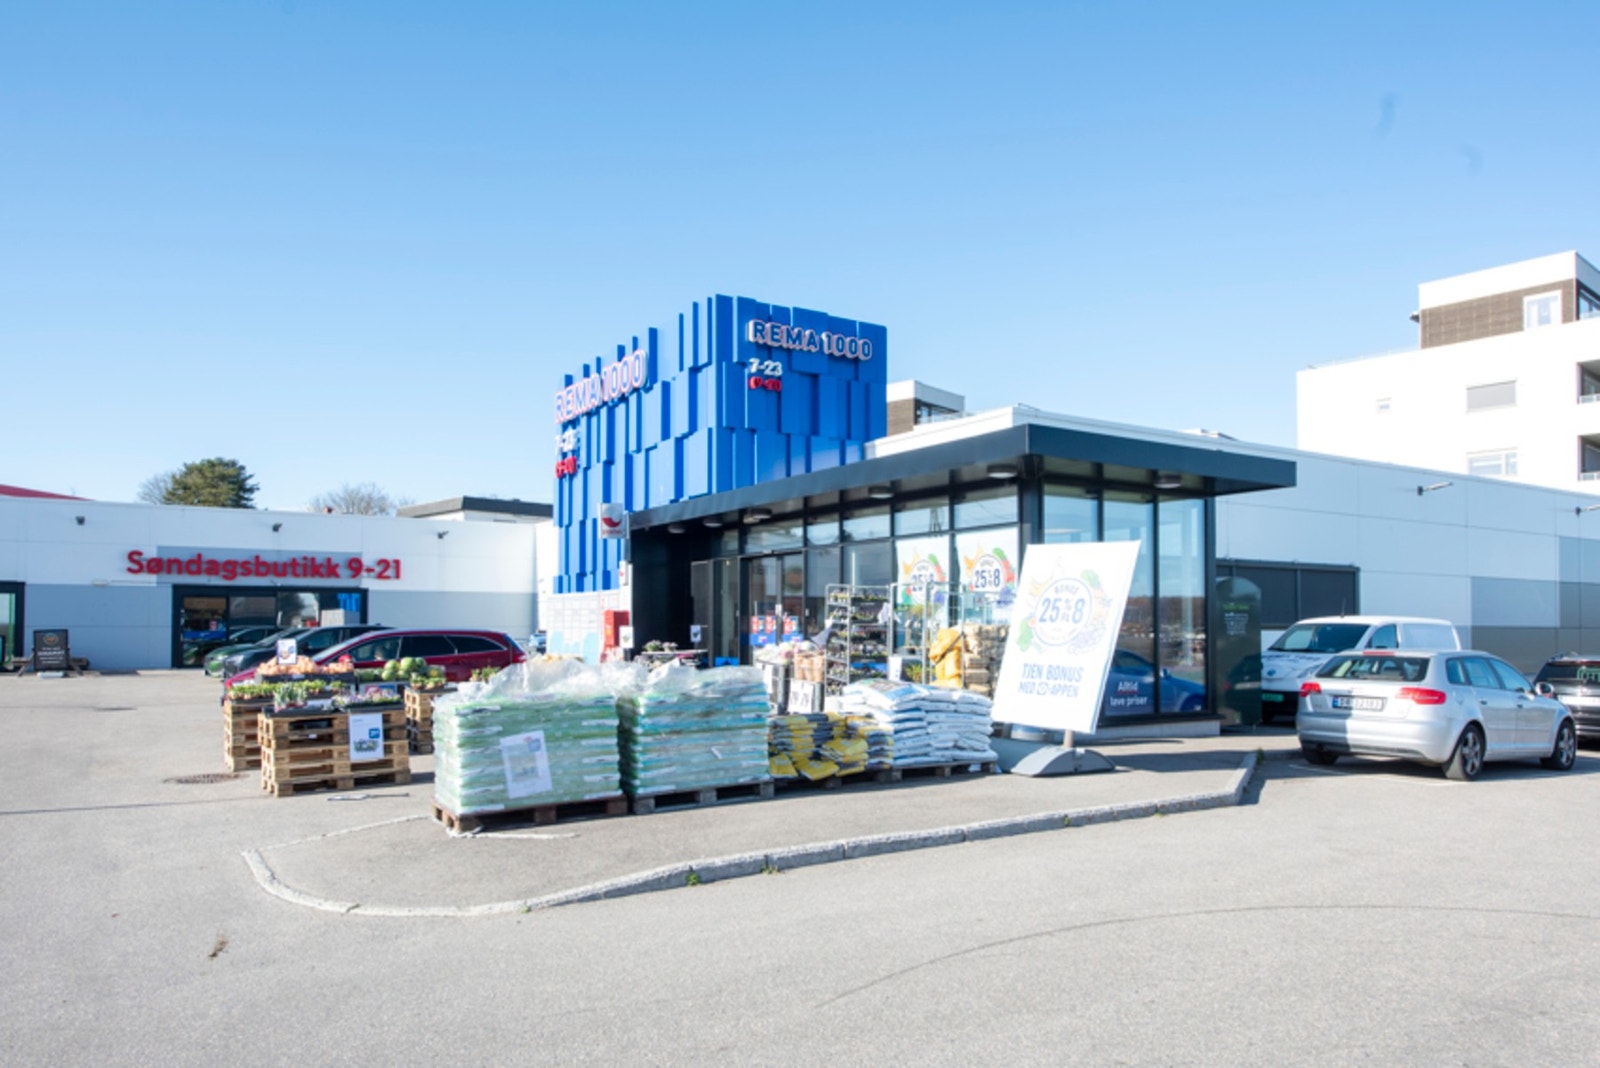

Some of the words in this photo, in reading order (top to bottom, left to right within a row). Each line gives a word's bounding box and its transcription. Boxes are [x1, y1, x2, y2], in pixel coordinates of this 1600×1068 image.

[748, 320, 820, 352] REMA
[821, 331, 872, 360] 1000
[749, 358, 783, 376] 7-23
[554, 373, 601, 425] REMA
[601, 349, 647, 403] 1000
[126, 550, 340, 581] Søndagsbutikk
[347, 557, 402, 580] 9-21
[975, 569, 987, 588] 25
[993, 568, 1001, 588] 8
[1039, 597, 1062, 623] 25
[1072, 598, 1086, 624] 8
[1046, 664, 1084, 683] BONUS
[1117, 680, 1138, 692] Alltid
[1110, 696, 1125, 707] lave
[1127, 695, 1148, 708] priser
